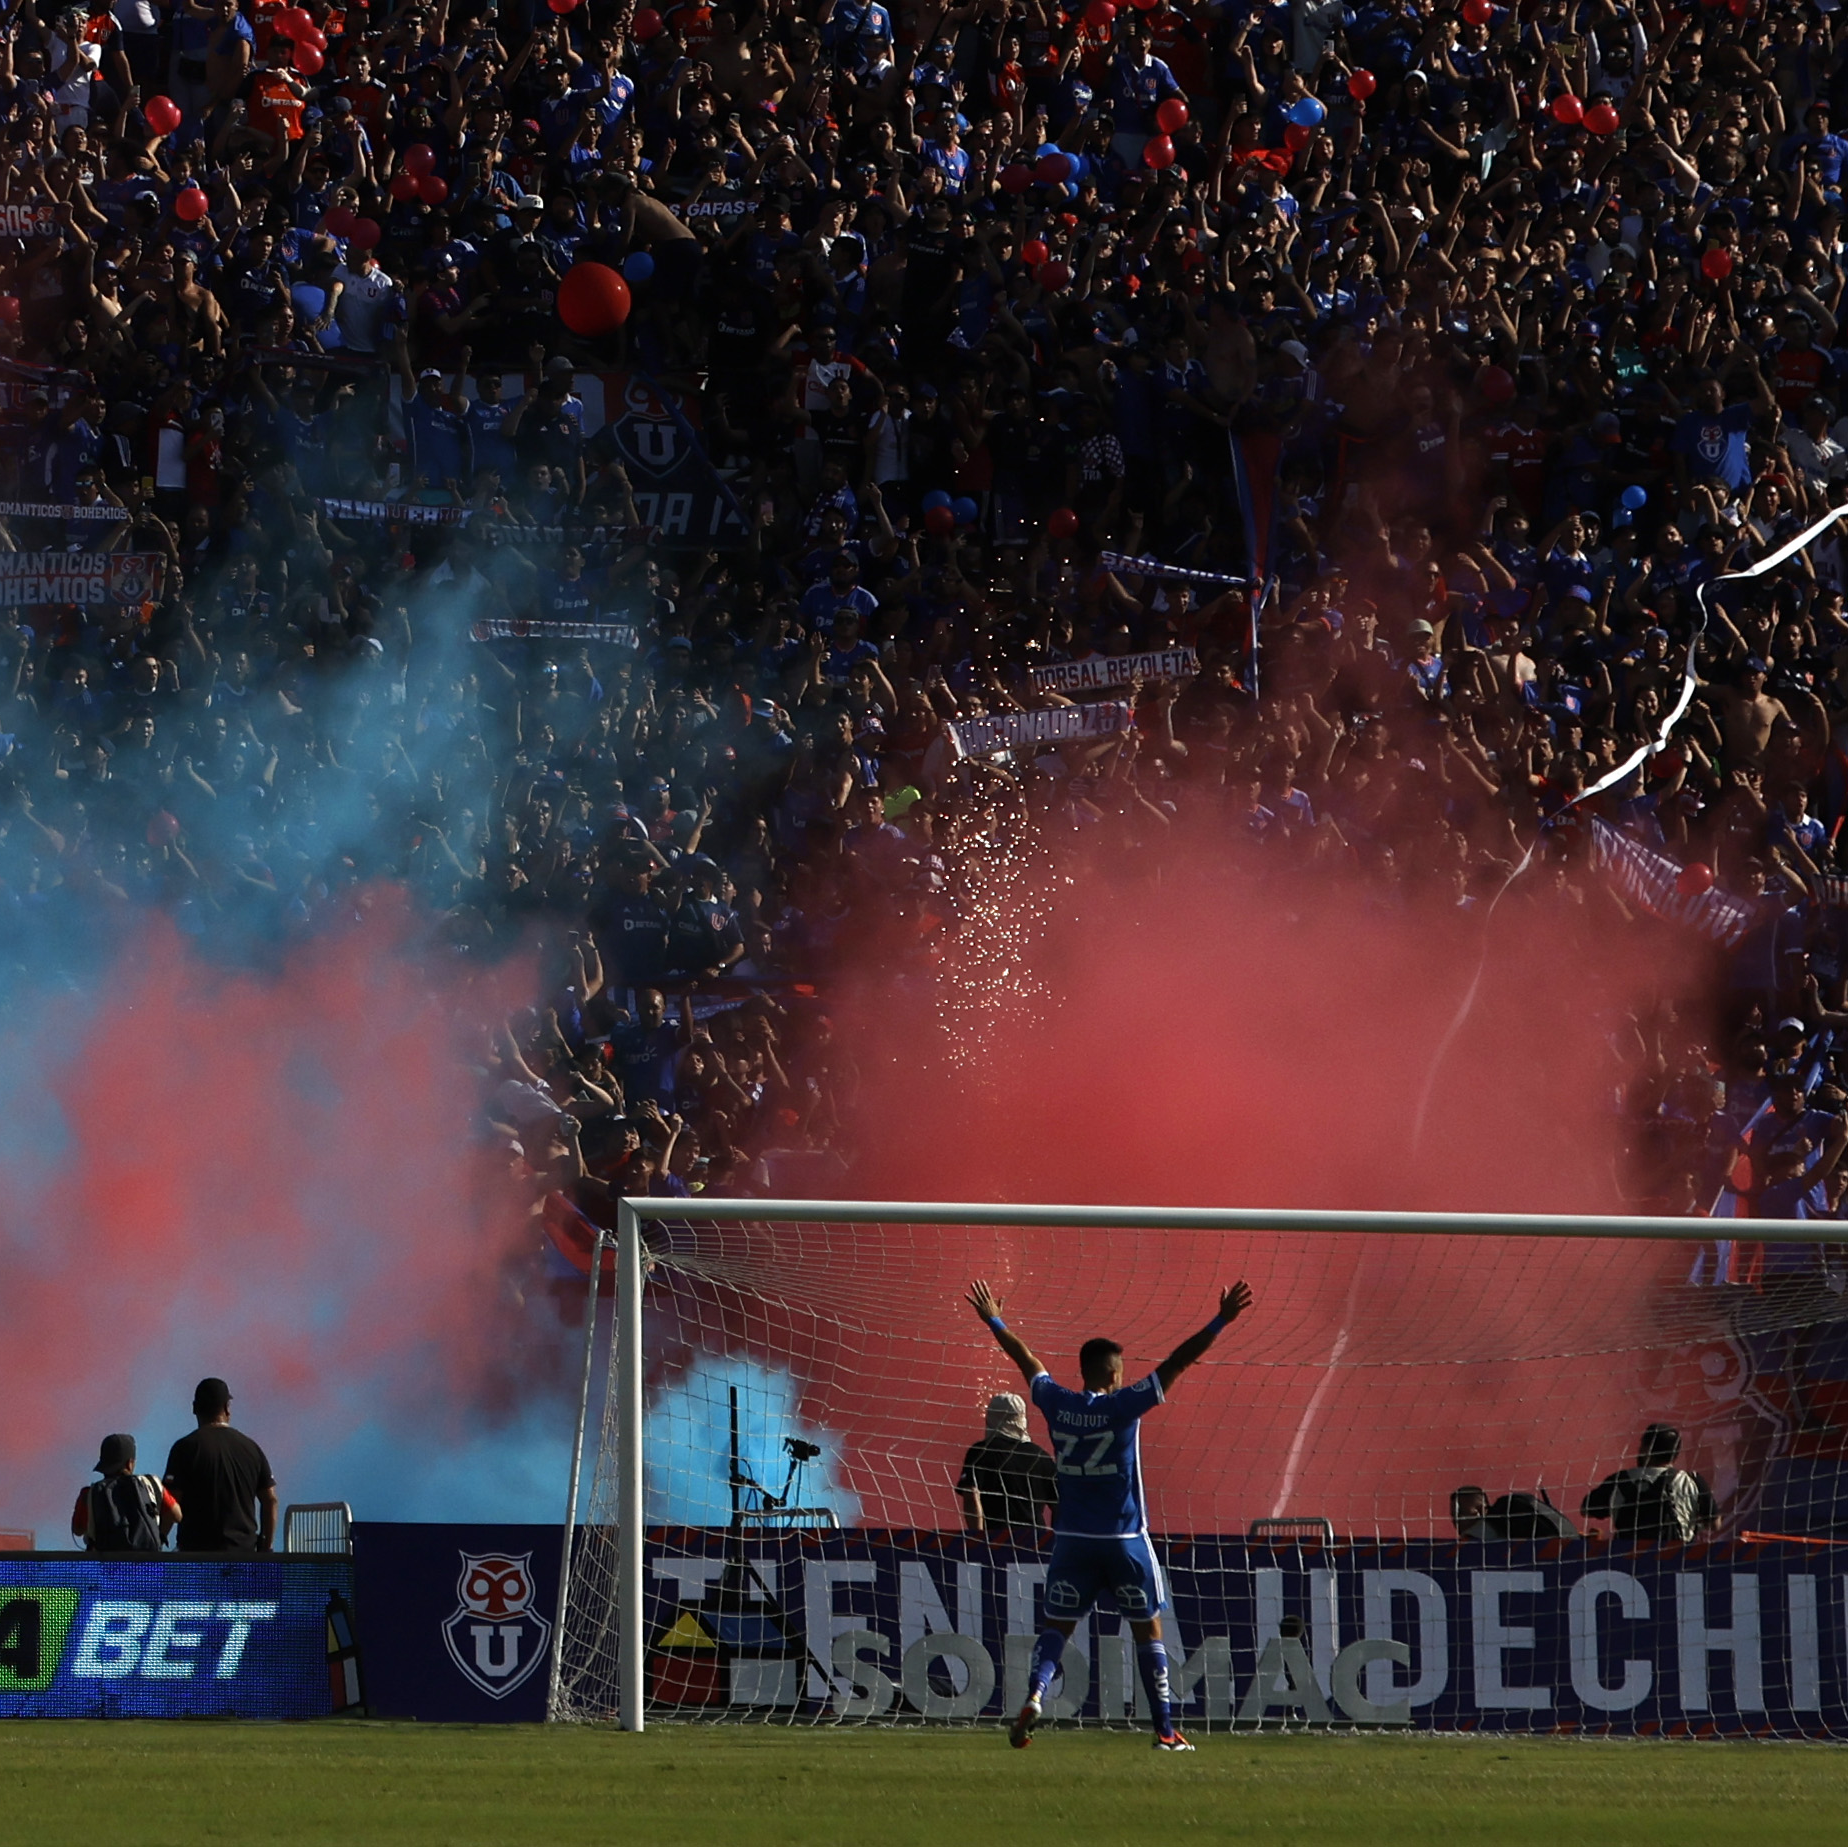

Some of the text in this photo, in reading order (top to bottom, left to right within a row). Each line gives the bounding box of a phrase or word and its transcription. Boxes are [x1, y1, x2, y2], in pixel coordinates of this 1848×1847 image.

[687, 201, 746, 217] GAFAS
[74, 504, 128, 521] BOHEMIOS
[1052, 1431, 1119, 1476] 22
[72, 1600, 278, 1679] BET
[1255, 1567, 1848, 1712] UDECHI
[833, 1630, 1412, 1723] SODIMAC
